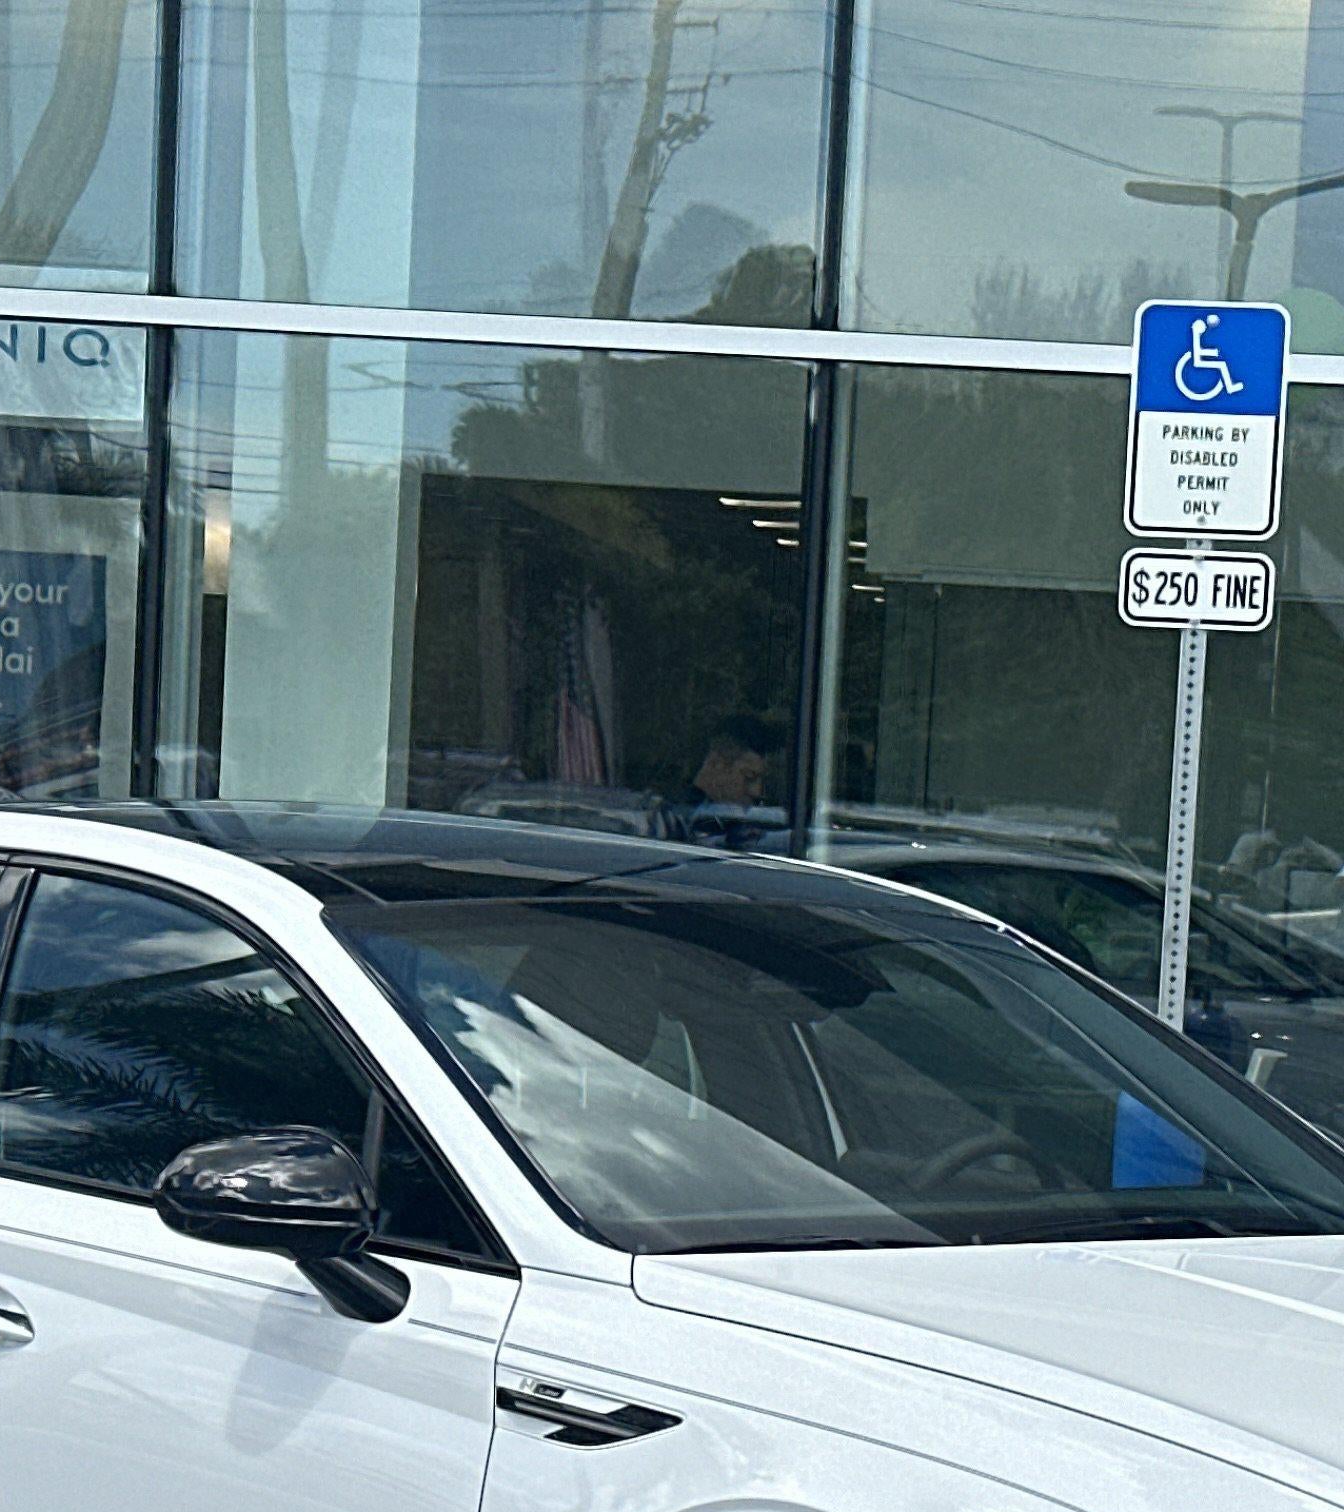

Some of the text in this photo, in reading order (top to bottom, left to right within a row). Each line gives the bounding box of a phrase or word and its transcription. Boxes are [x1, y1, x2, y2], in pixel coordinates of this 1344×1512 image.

[1162, 424, 1250, 443] PARKING BY
[1170, 450, 1238, 467] DISABLED
[1177, 475, 1230, 492] PERMIT
[1183, 500, 1220, 516] ONLY
[1132, 568, 1262, 610] $250 FINE
[0, 616, 20, 637] a
